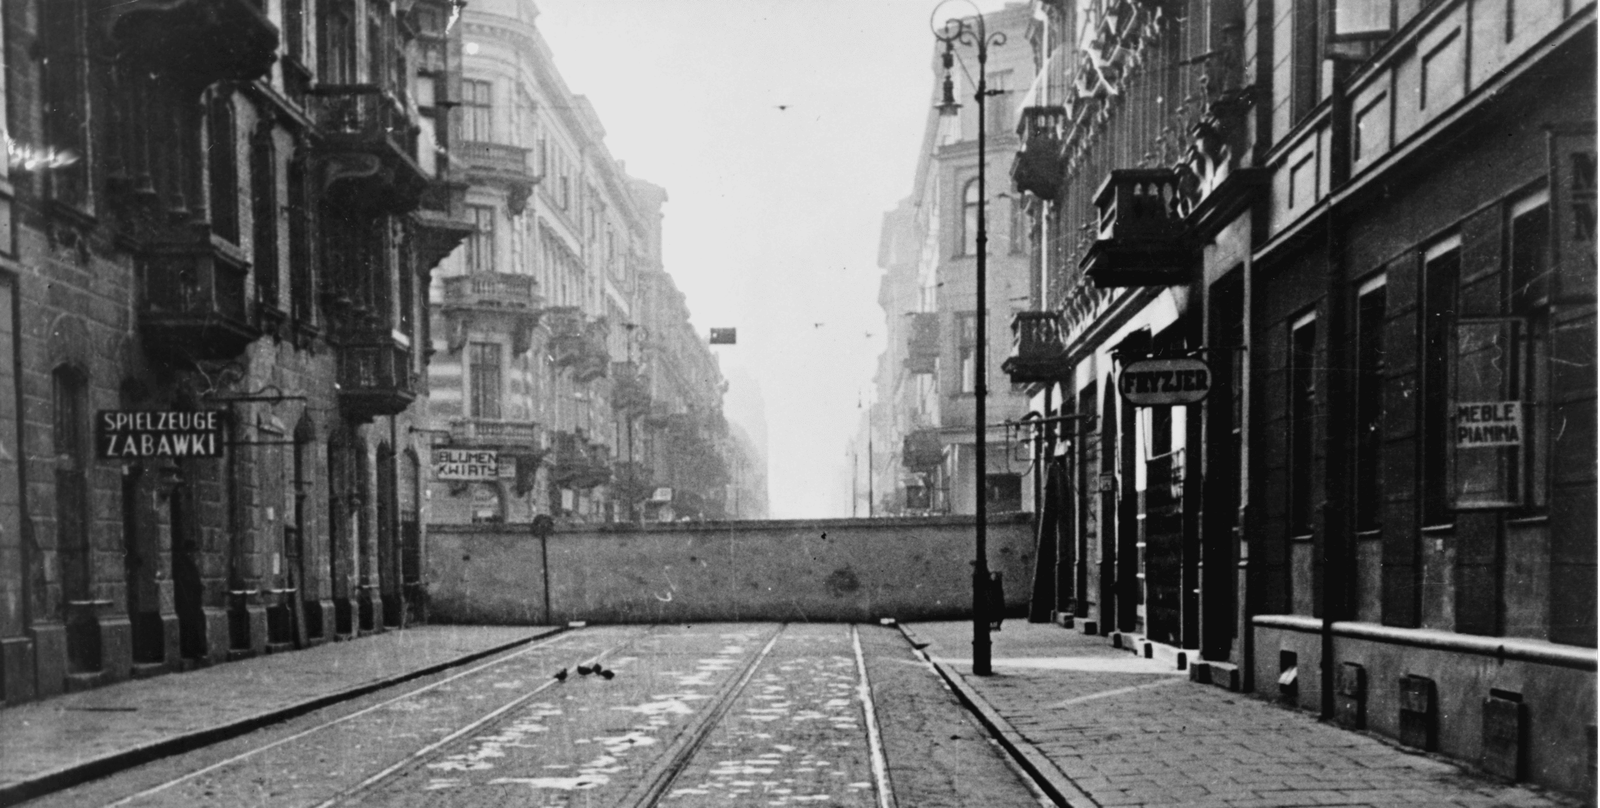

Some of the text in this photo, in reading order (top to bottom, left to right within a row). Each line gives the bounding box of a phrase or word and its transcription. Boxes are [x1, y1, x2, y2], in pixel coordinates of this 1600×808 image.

[1123, 370, 1208, 393] FRYZJER
[104, 411, 217, 430] SPIELZEUGE
[1457, 404, 1515, 422] MEBLE
[1458, 425, 1519, 443] PIANINA
[105, 433, 215, 456] ZABAWKI
[440, 451, 499, 463] BLUMEN
[440, 464, 498, 476] KWIATY
